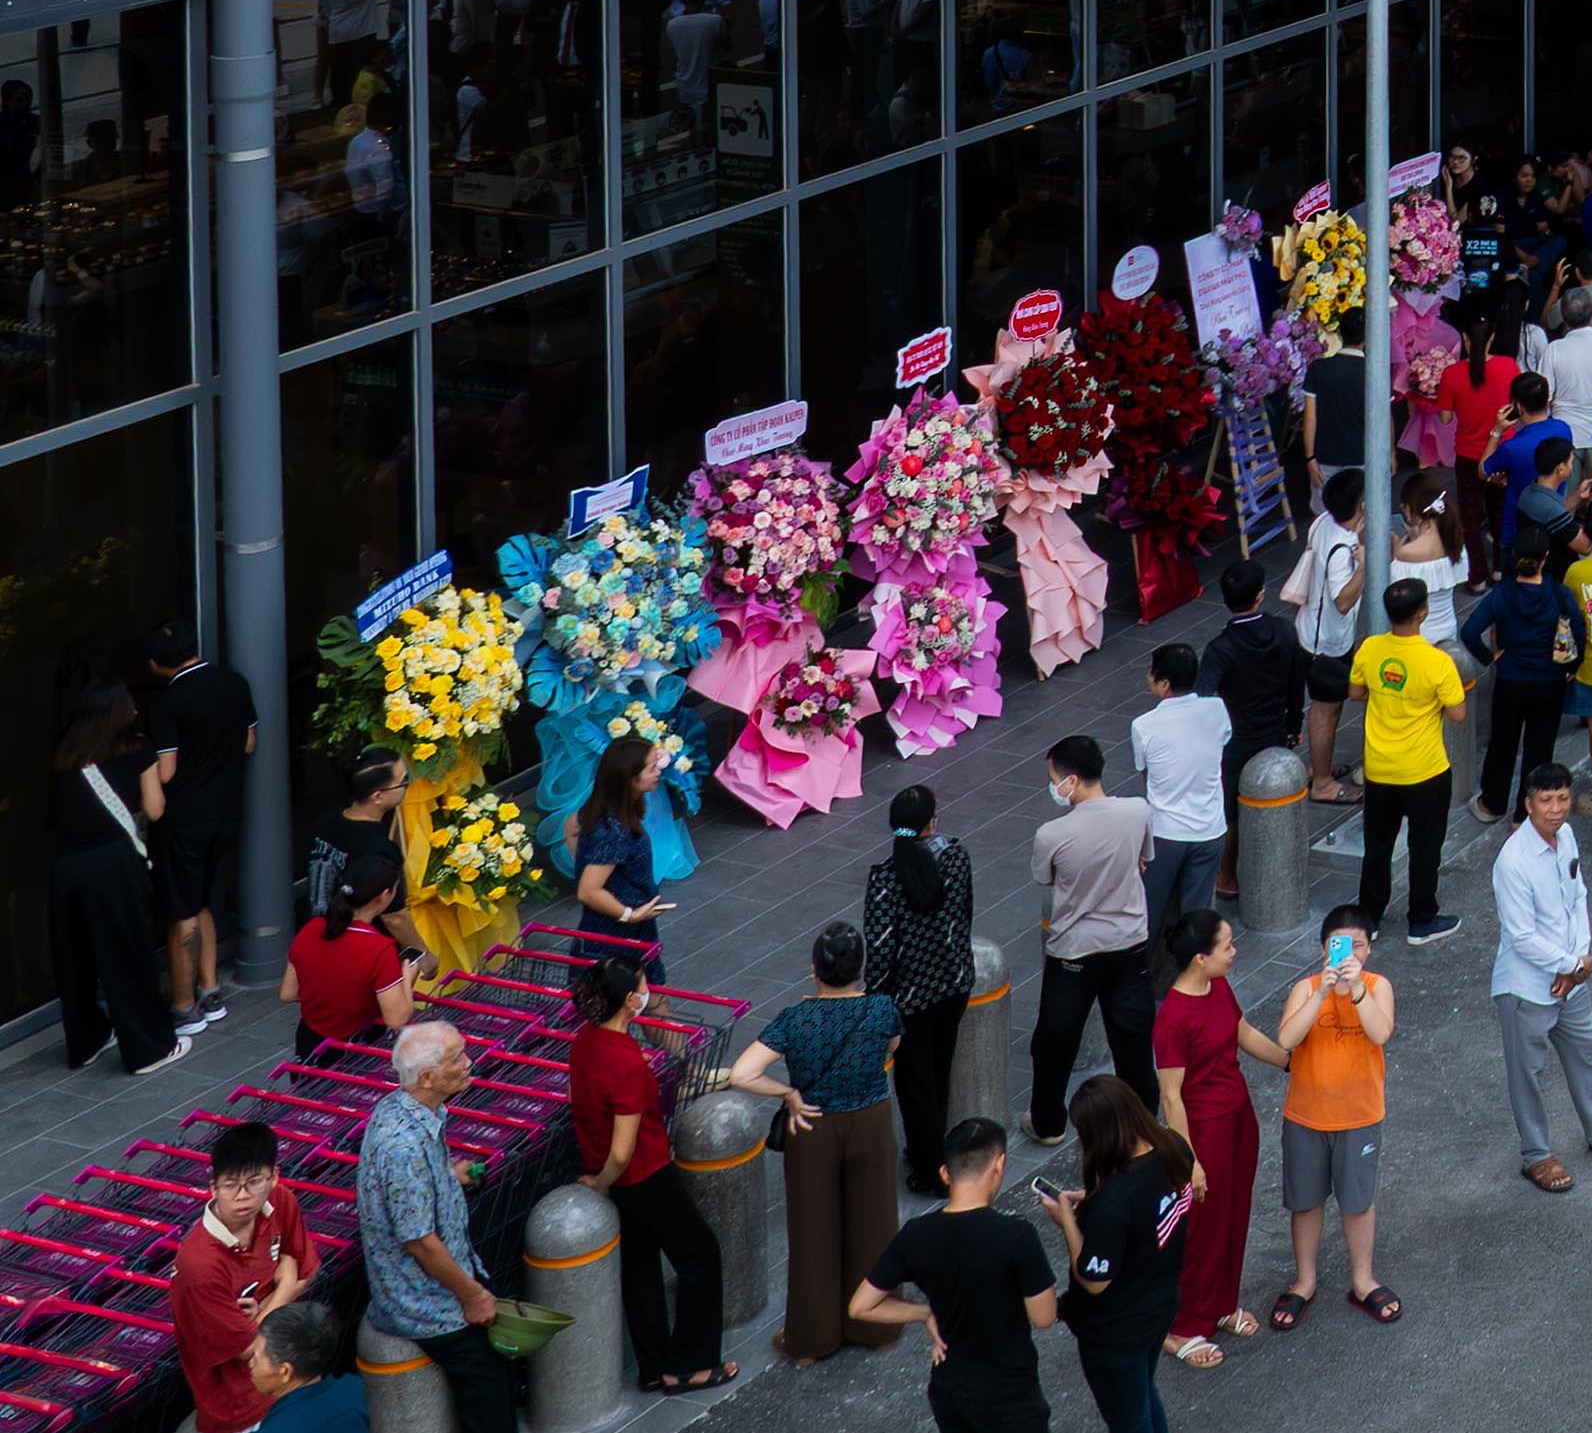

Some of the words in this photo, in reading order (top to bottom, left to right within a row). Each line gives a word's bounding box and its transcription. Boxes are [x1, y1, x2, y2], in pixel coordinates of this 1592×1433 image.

[374, 586, 412, 619] MIZUHO
[412, 568, 440, 592] BANK
[1087, 1255, 1109, 1274] Aa
